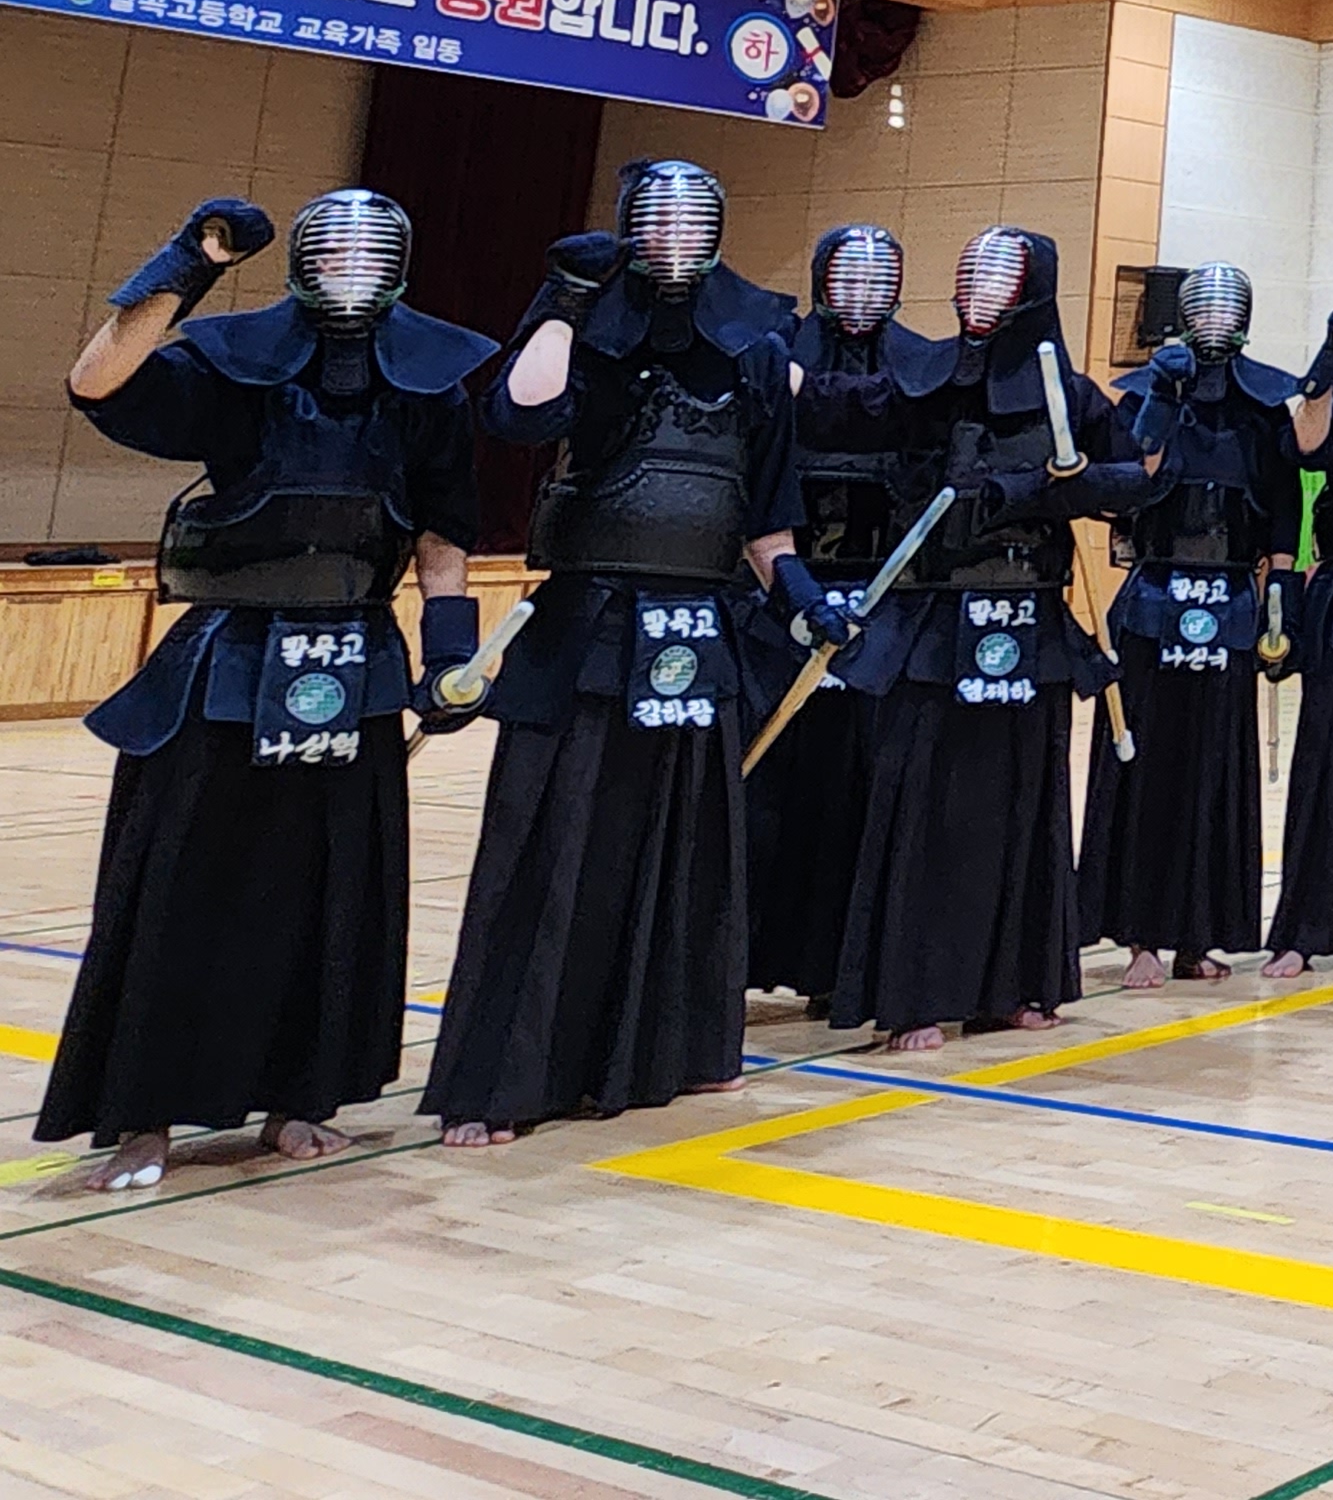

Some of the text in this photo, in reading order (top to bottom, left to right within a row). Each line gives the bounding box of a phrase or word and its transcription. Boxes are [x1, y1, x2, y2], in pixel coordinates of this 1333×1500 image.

[293, 16, 402, 56] 교육가족
[412, 33, 464, 64] 일동
[742, 29, 781, 73] 하
